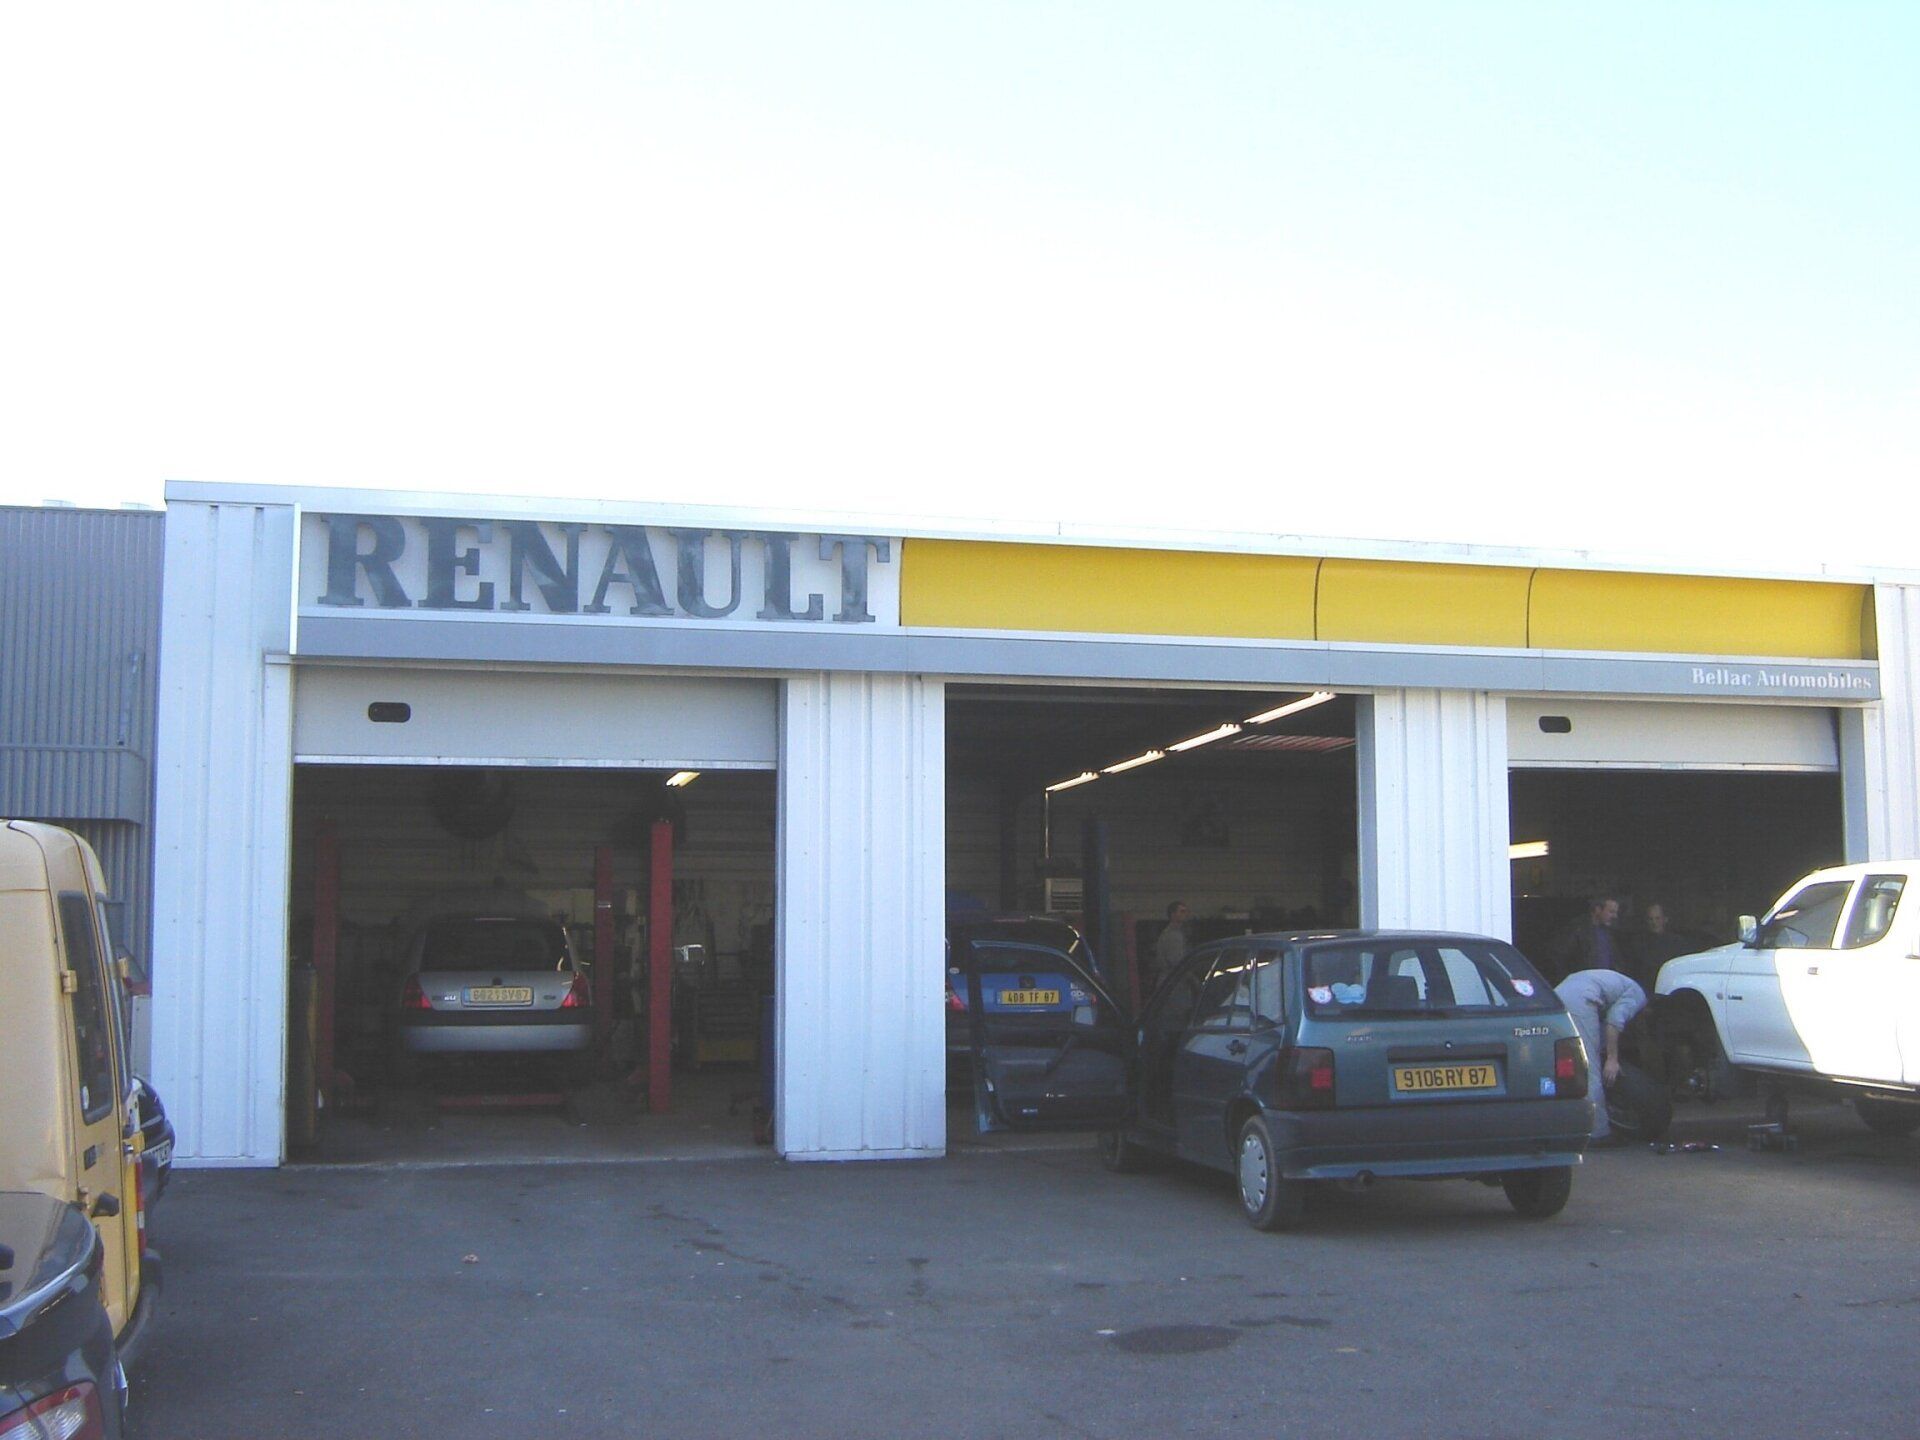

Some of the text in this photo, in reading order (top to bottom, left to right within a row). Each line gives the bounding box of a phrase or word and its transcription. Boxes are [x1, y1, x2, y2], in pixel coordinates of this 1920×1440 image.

[316, 513, 891, 623] RENAULT
[1691, 667, 1872, 689] Bellac Automobiles
[1468, 1068, 1487, 1085] 87
